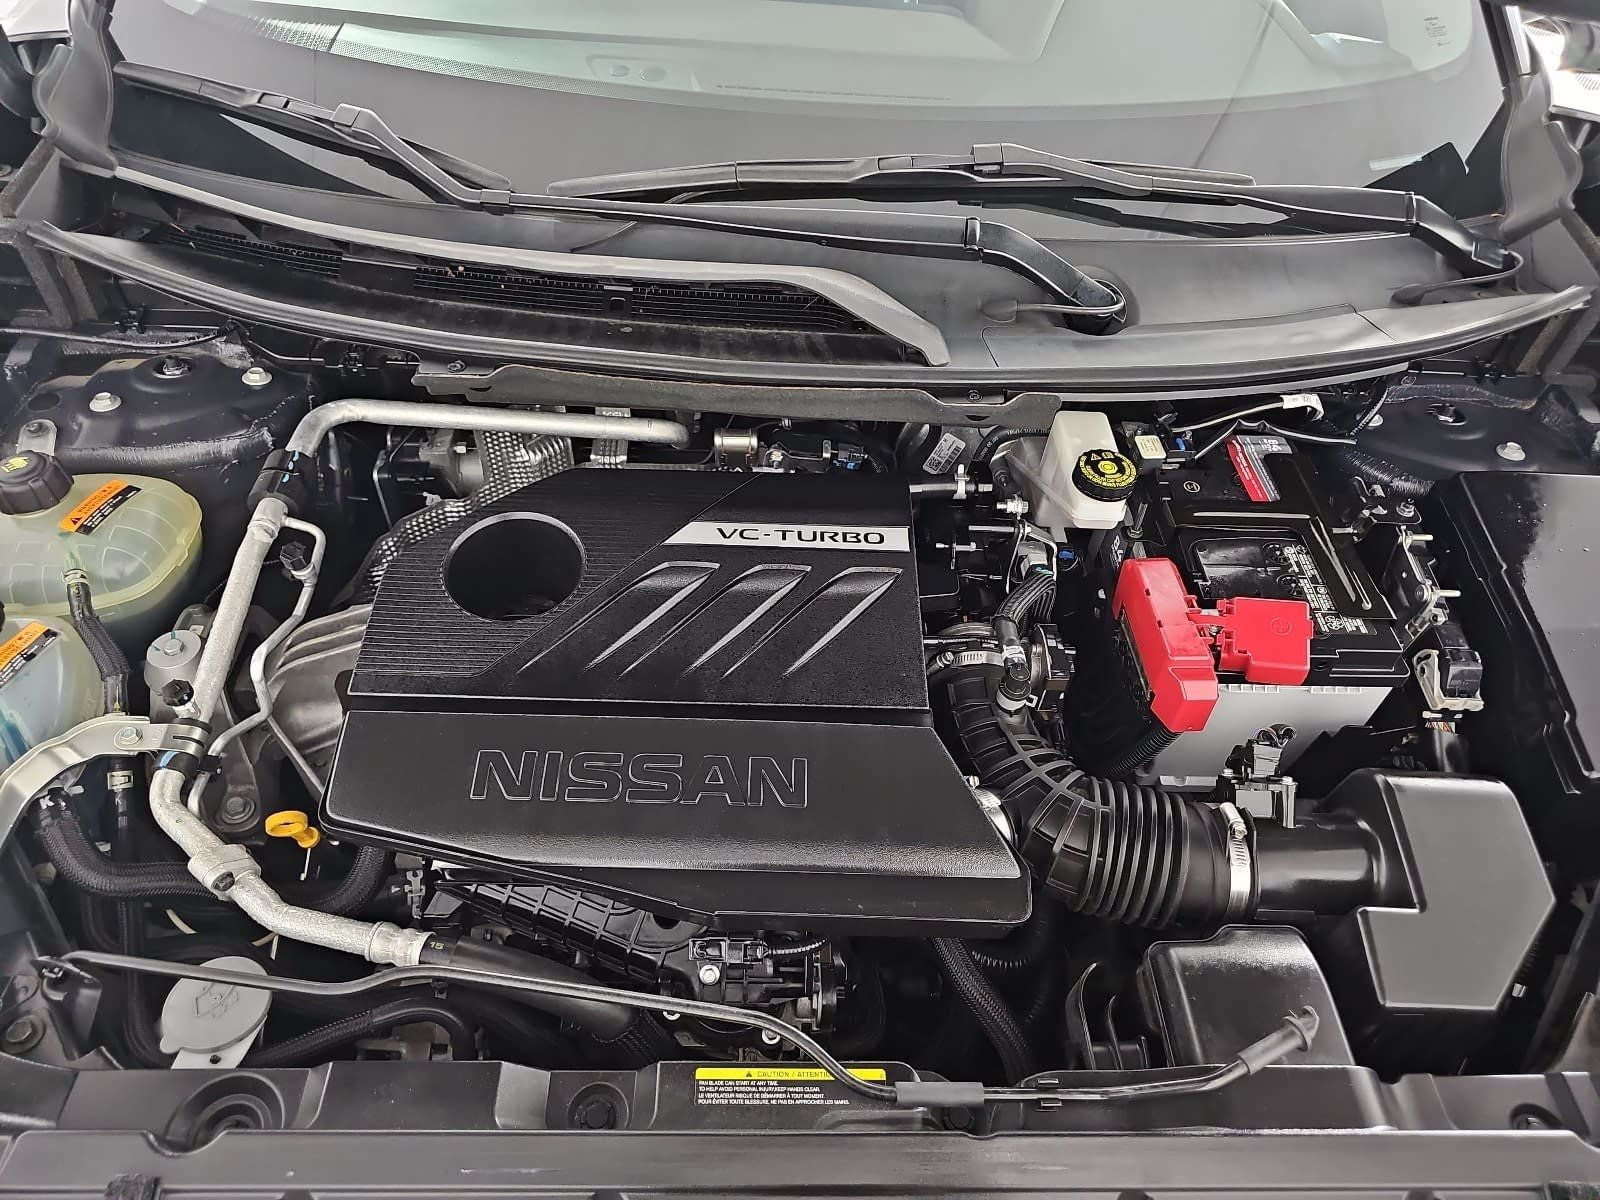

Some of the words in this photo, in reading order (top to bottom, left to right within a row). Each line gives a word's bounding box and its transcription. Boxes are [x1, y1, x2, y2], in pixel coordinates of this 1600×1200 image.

[716, 527, 885, 545] VC-TURBO
[470, 749, 807, 808] NISSAN
[430, 940, 445, 950] 15
